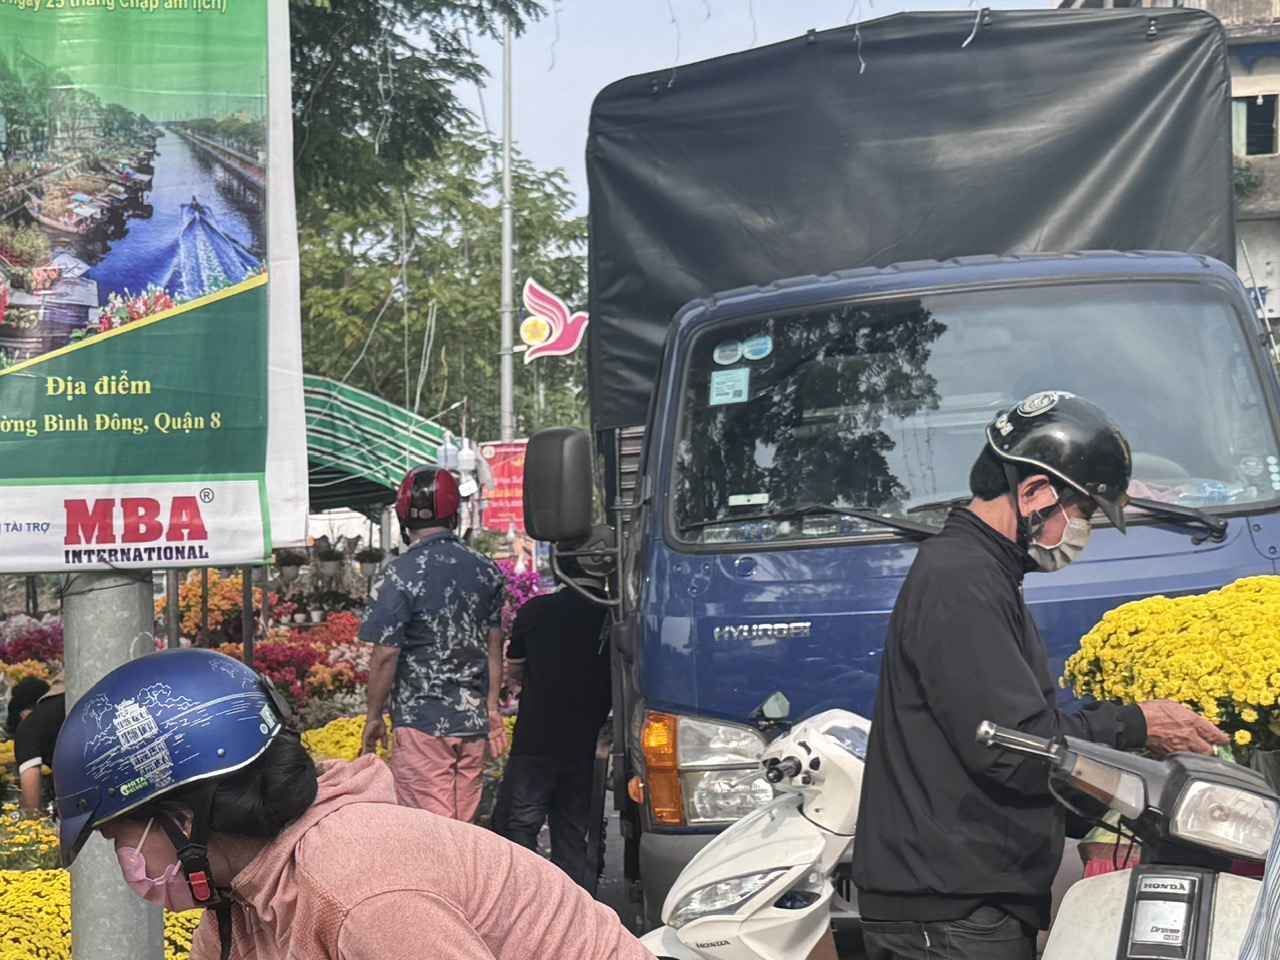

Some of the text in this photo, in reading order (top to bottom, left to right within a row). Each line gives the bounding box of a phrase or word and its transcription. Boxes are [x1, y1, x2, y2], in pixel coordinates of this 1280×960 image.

[45, 370, 152, 401] Địa điểm
[43, 413, 89, 432] Bình
[95, 413, 149, 434] Đông,
[154, 411, 205, 433] Quận
[210, 411, 221, 429] 8
[5, 521, 22, 533] TÀI
[26, 522, 50, 533] TRỢ
[64, 496, 208, 545] MBA
[64, 546, 209, 564] INTERNATIONAL
[1143, 882, 1186, 891] HONDA
